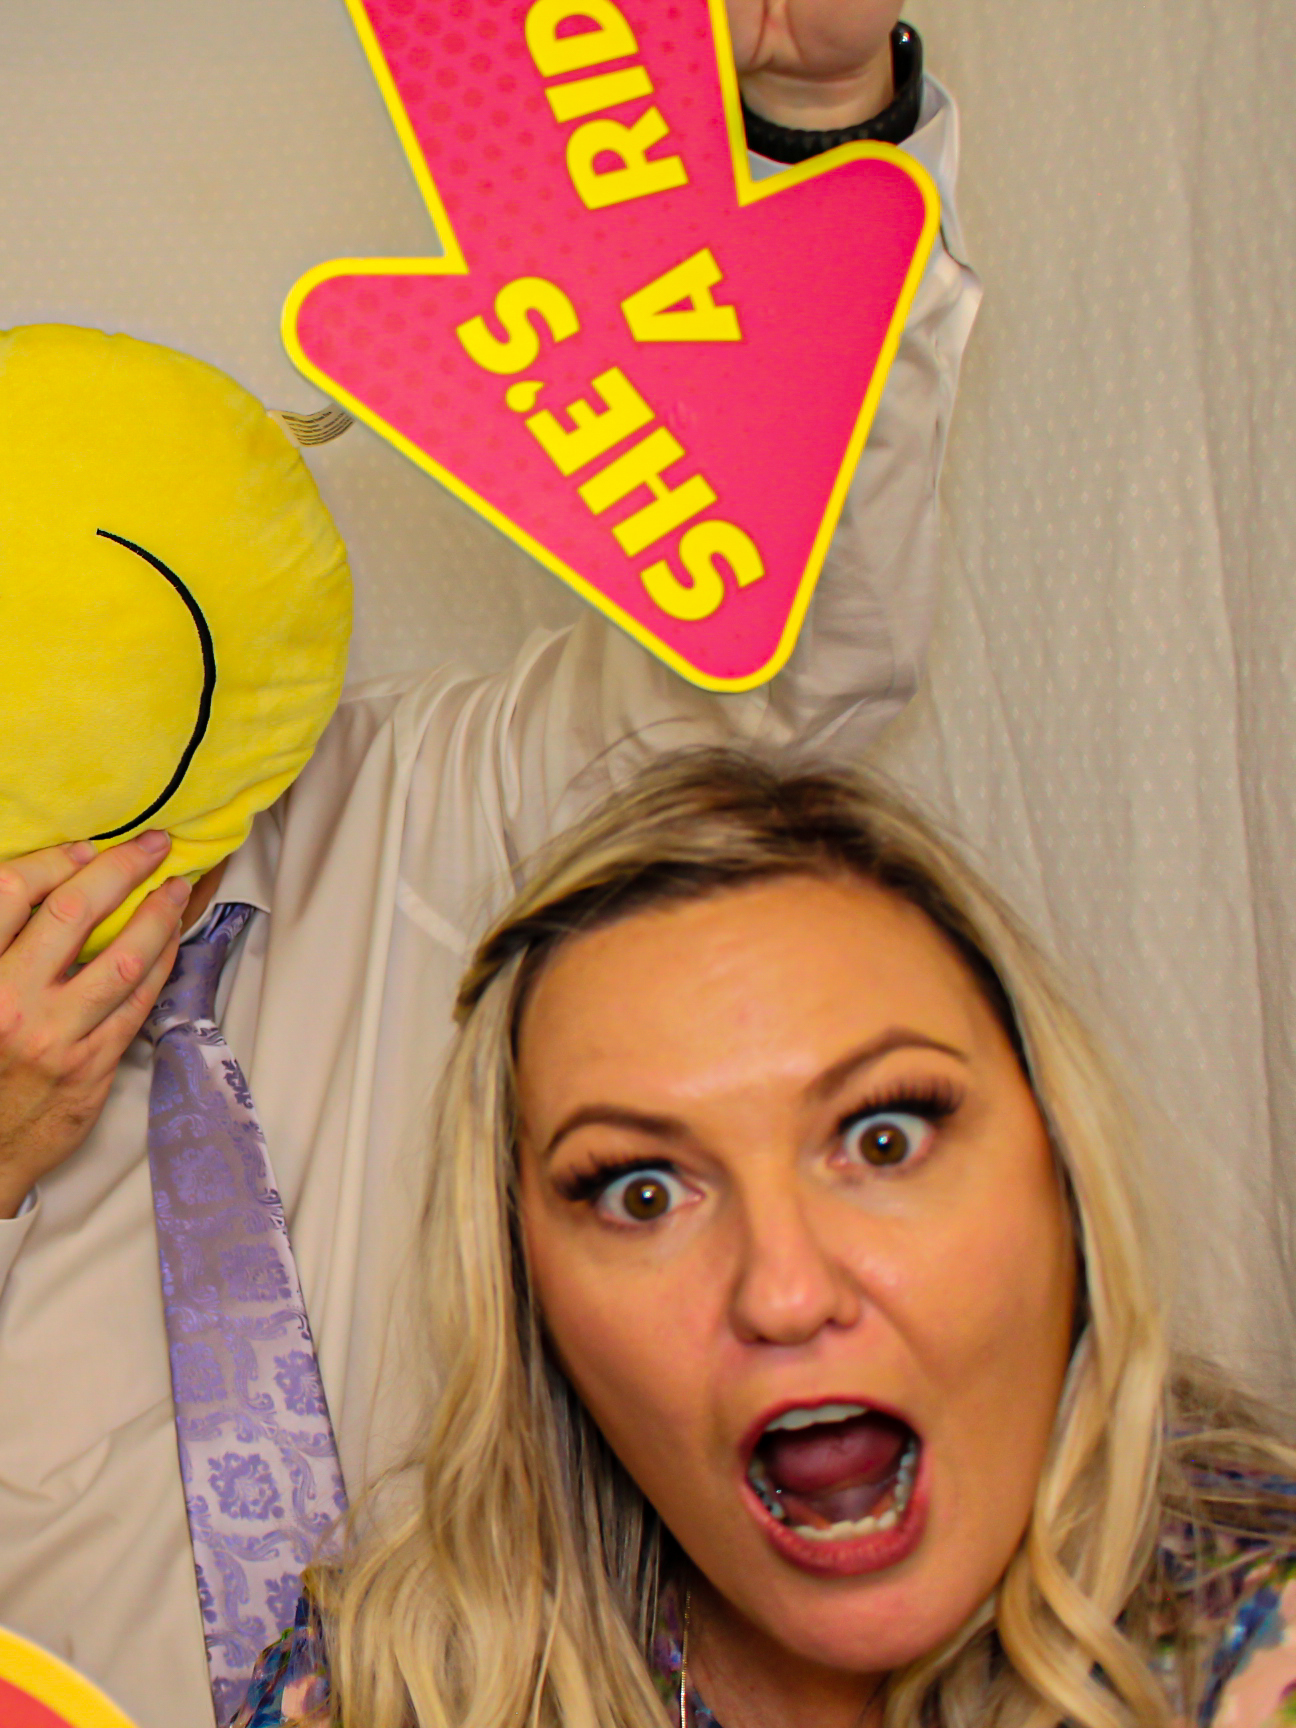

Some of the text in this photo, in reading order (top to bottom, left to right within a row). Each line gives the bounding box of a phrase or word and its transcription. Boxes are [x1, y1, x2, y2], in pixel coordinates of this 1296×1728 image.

[524, 0, 742, 342] A RID
[456, 276, 765, 621] SHE'S
